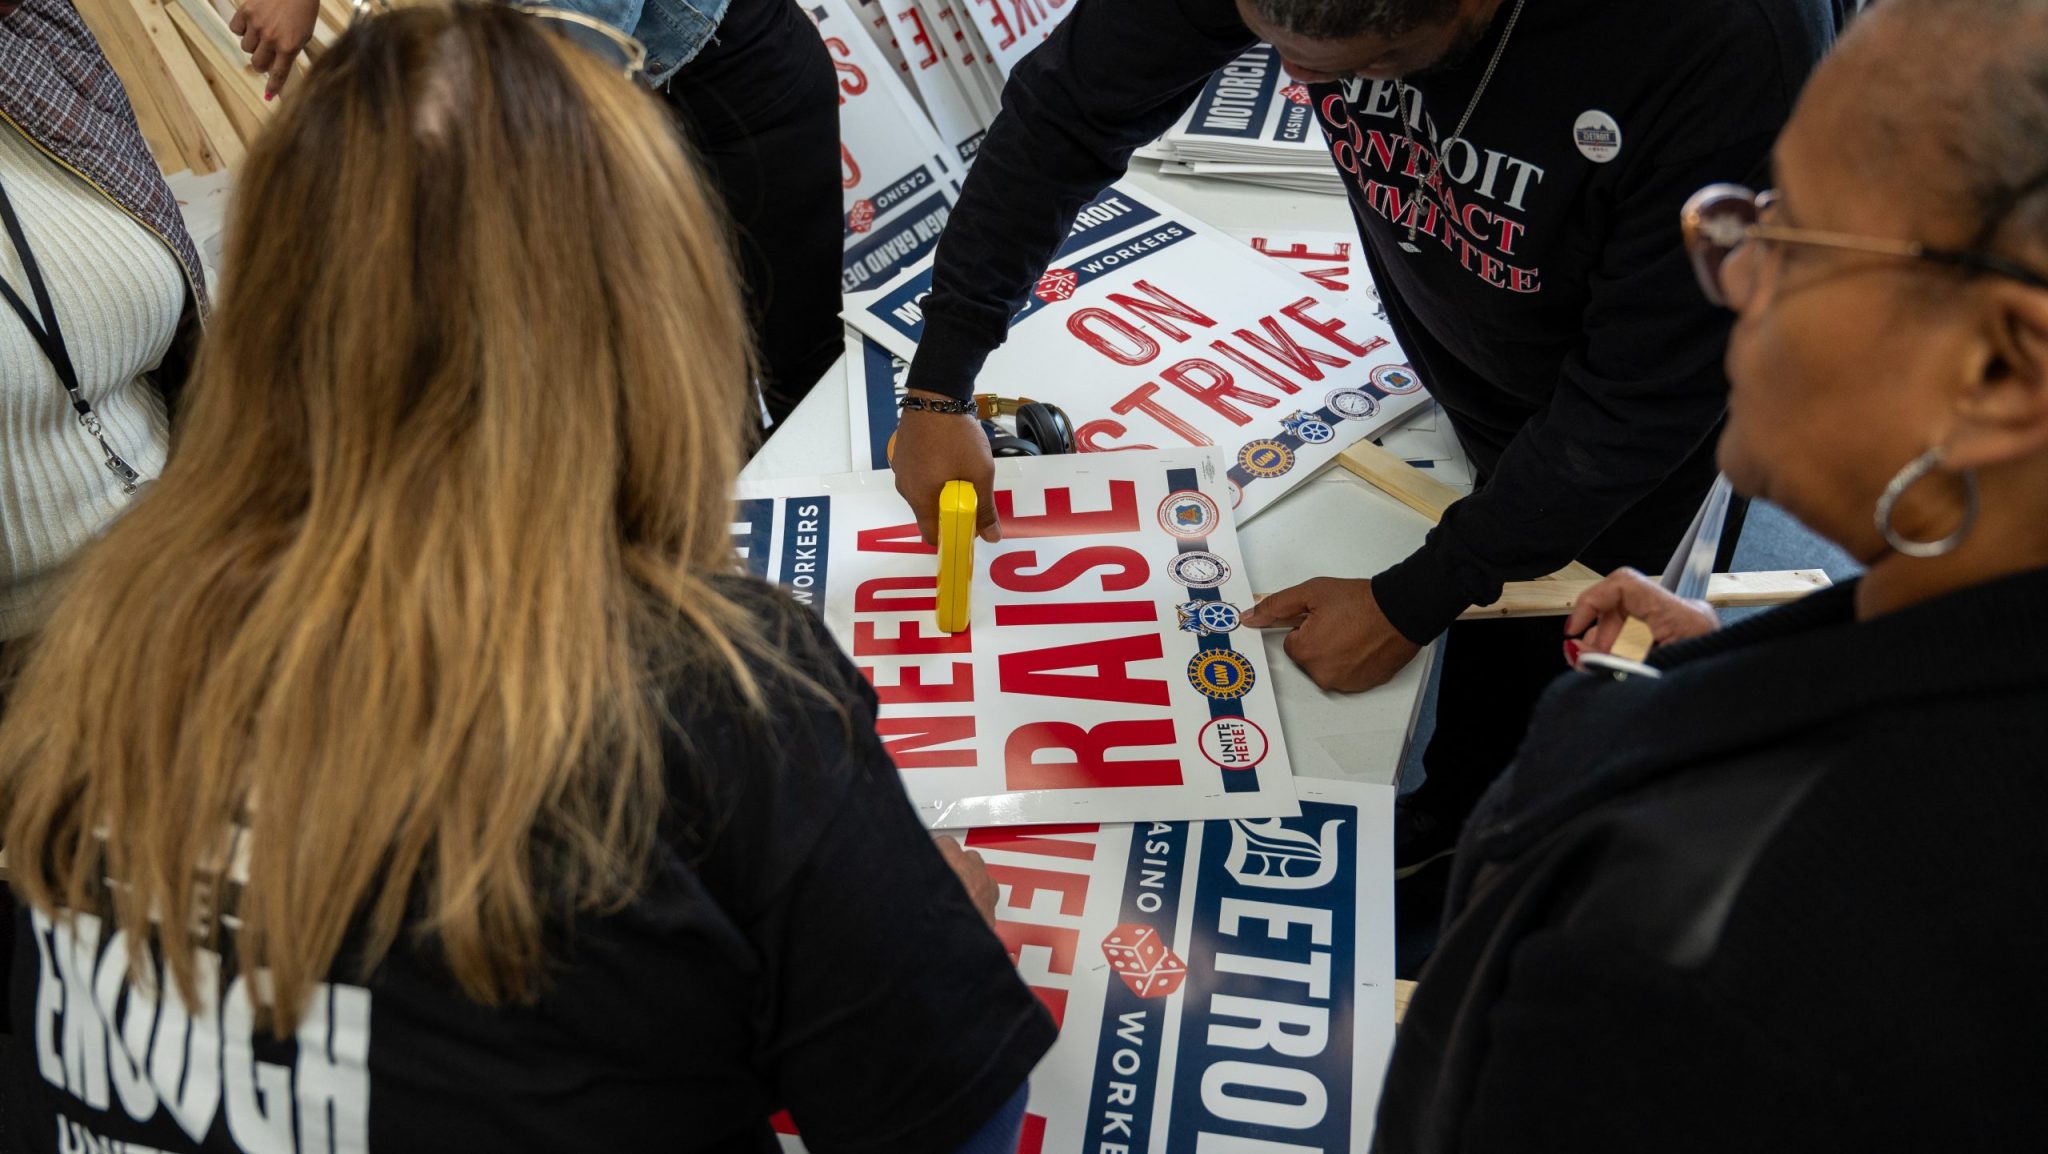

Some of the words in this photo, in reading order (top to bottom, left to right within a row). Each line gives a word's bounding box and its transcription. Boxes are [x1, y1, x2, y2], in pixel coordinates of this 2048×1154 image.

[1284, 106, 1307, 139] CASINO
[877, 170, 927, 209] CASINO
[864, 228, 919, 274] GRAND
[1080, 227, 1183, 275] WORKERS
[1066, 279, 1218, 367] ON
[1256, 450, 1277, 467] UAW
[792, 504, 819, 605] WORKERS
[989, 479, 1185, 791] RAISE
[853, 575, 978, 769] NEED
[1213, 663, 1230, 686] UAW
[1217, 723, 1237, 763] UNITE
[1231, 723, 1251, 763] HERE!
[1136, 821, 1173, 913] ASINO
[1196, 818, 1346, 1154] DETROI
[1098, 1010, 1147, 1154] WORKE
